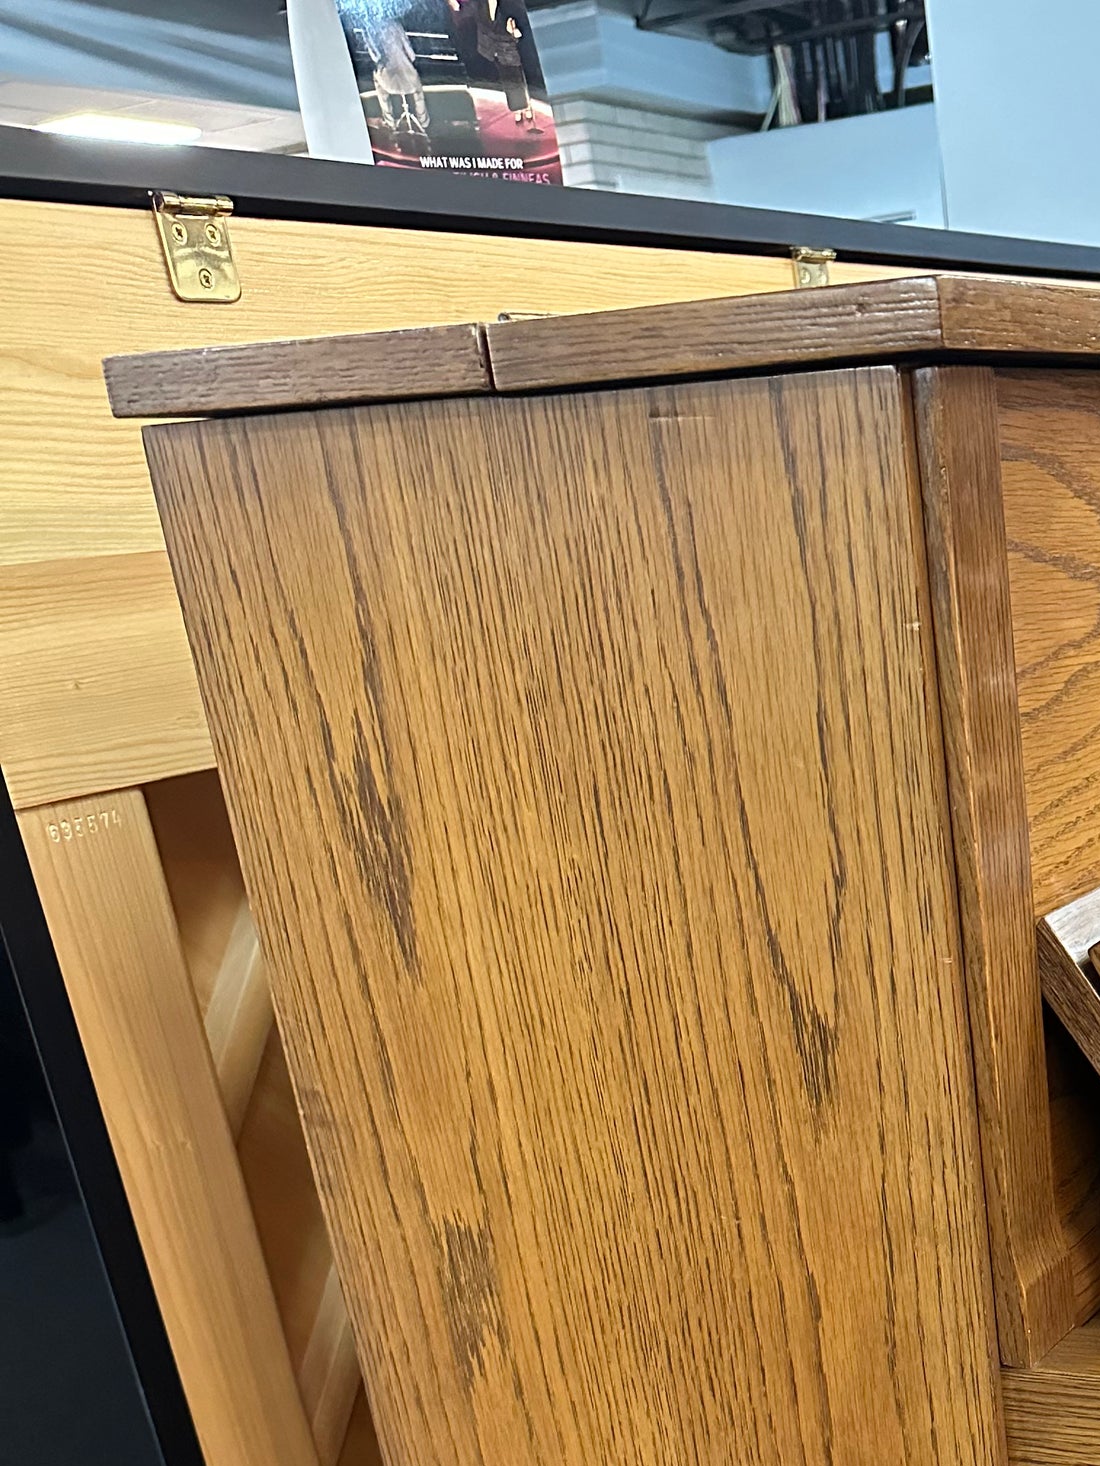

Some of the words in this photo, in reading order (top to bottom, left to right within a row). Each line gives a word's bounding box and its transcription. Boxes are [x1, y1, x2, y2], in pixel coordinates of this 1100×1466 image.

[419, 156, 448, 168] WHAT
[448, 156, 472, 169] WAS
[472, 157, 477, 169] I
[477, 157, 504, 169] MADE
[504, 158, 524, 169] FOR
[502, 172, 551, 185] FINNEAS
